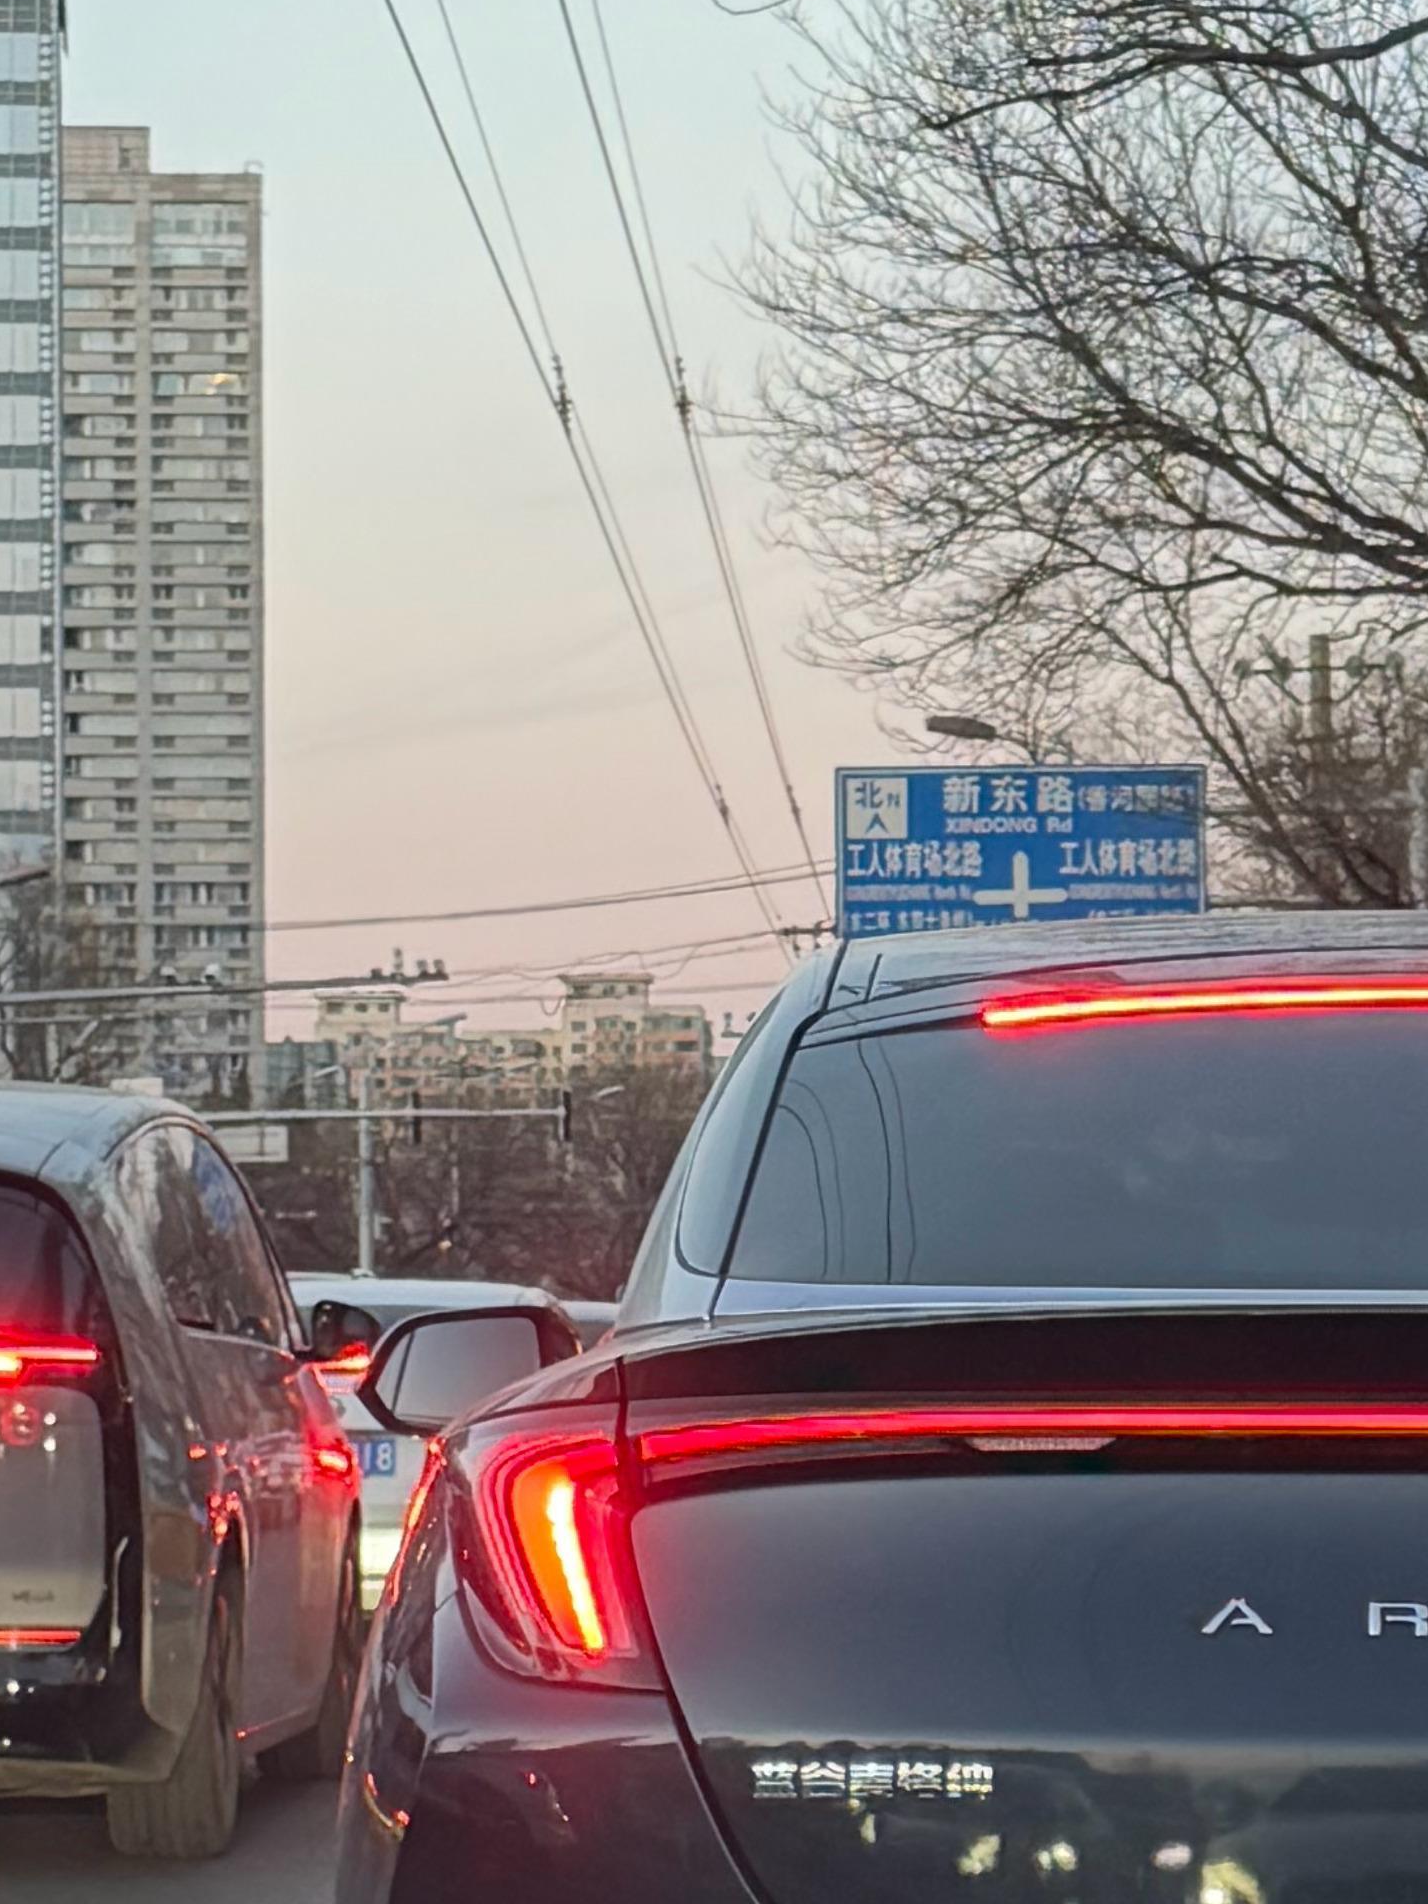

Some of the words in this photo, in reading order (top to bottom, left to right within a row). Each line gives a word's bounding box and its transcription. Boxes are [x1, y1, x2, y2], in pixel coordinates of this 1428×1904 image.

[855, 781, 883, 809] 北
[942, 775, 1074, 814] 新东路
[946, 816, 1037, 834] XINDONG
